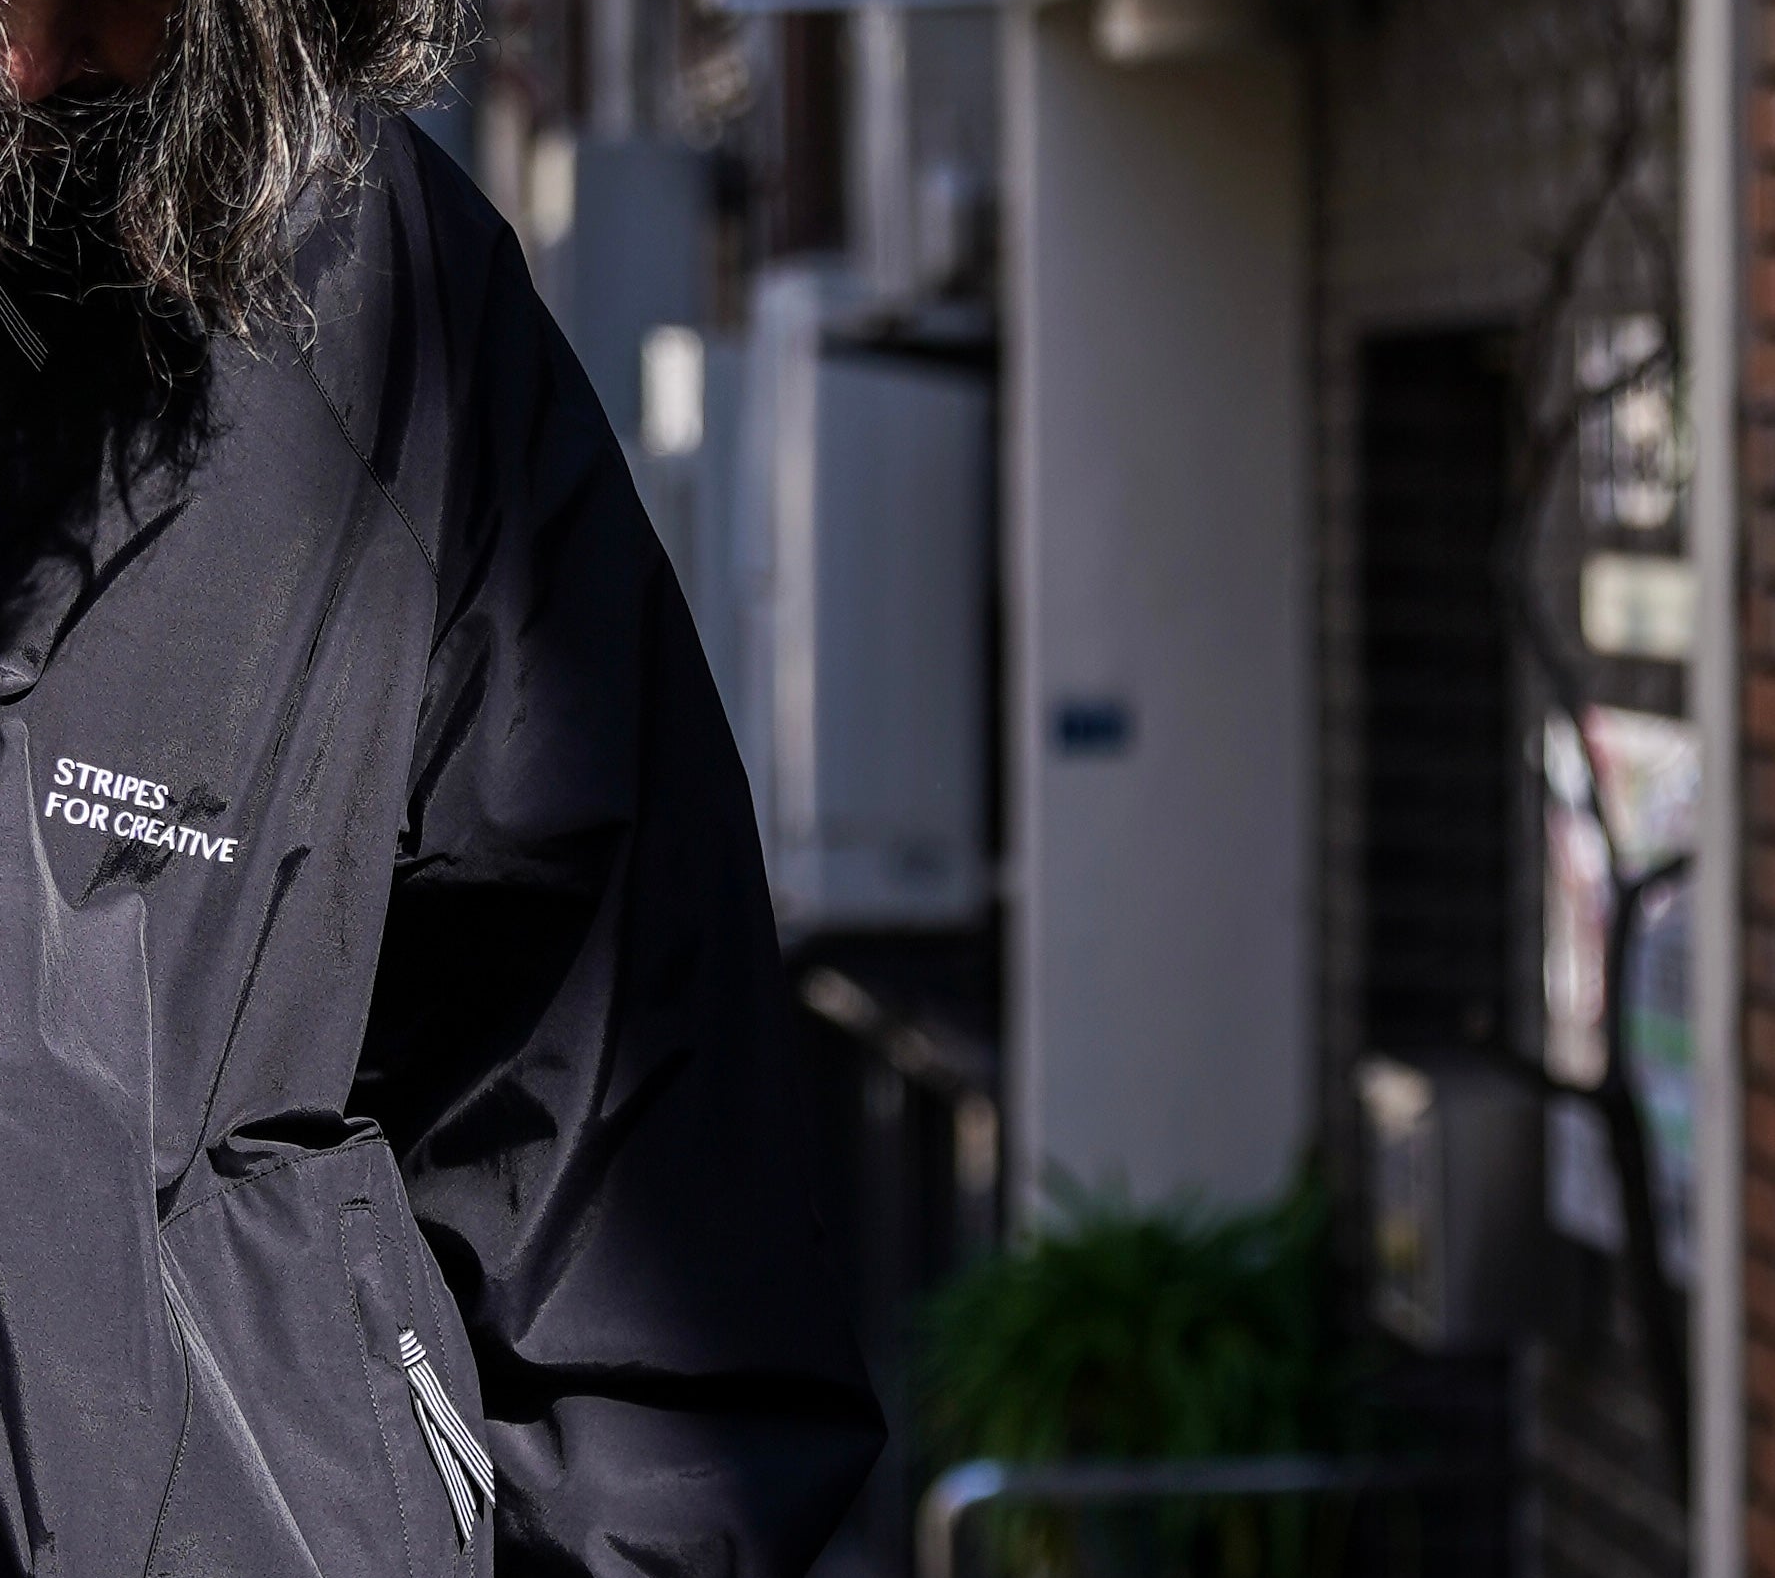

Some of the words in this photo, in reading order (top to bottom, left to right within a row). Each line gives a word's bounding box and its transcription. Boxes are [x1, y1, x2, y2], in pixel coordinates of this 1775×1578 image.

[53, 757, 169, 810] STRIPES
[45, 791, 110, 832] FOR
[114, 811, 239, 863] CREATIVE
